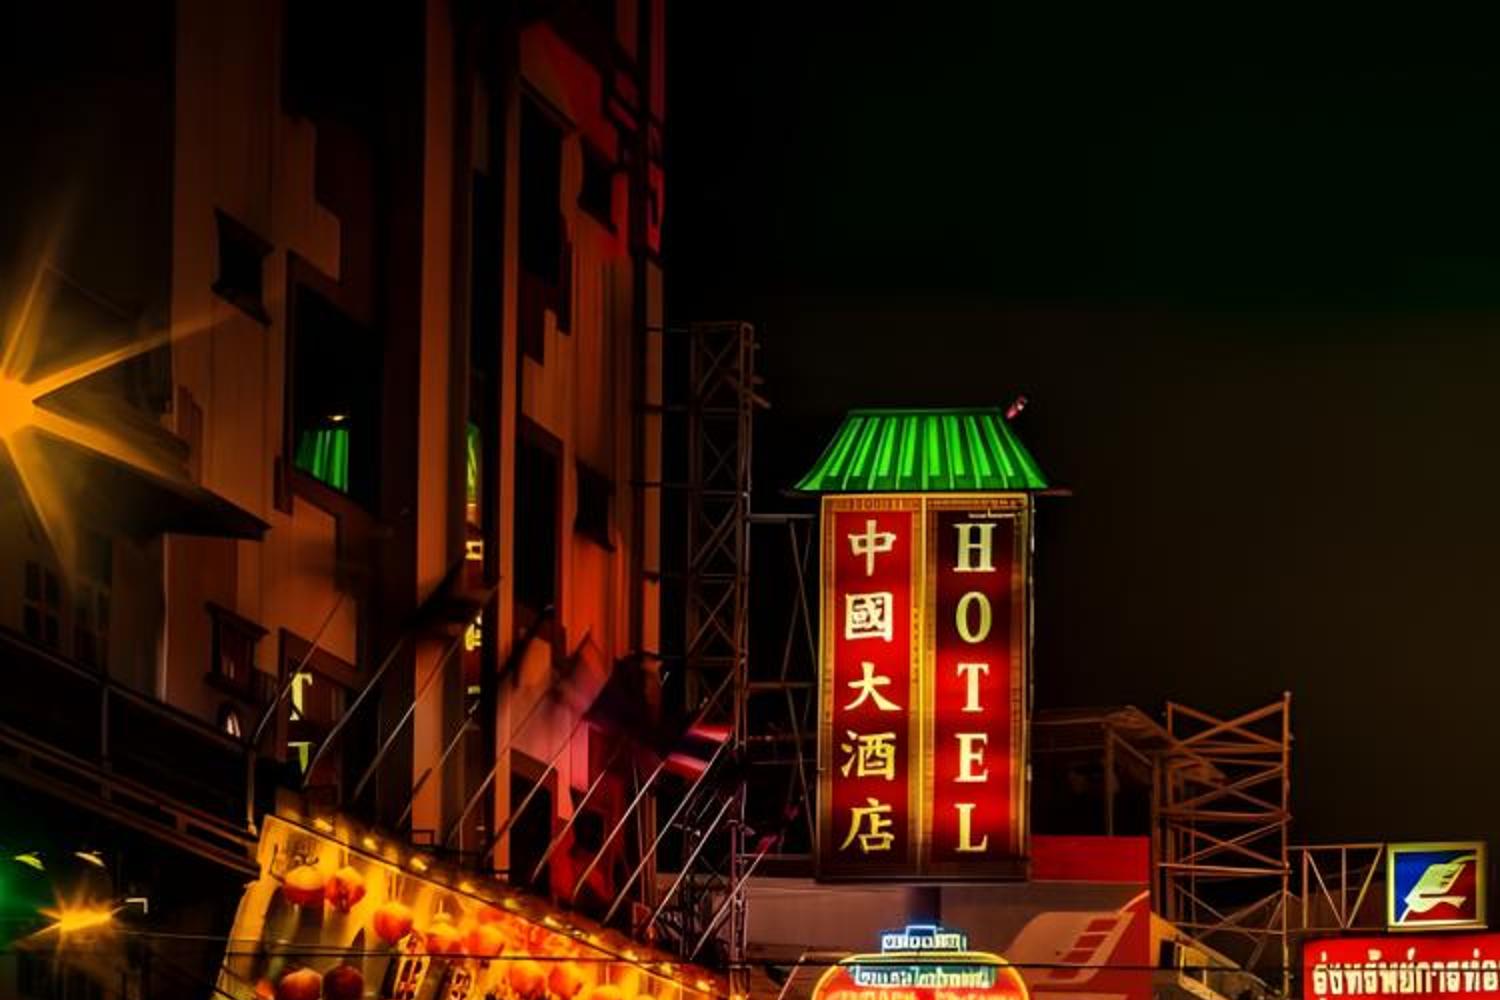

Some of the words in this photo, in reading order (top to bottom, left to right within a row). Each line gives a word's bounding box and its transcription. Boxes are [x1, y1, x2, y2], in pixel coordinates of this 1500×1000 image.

[838, 519, 904, 855] 中國大酒店
[952, 522, 998, 853] HOTEL
